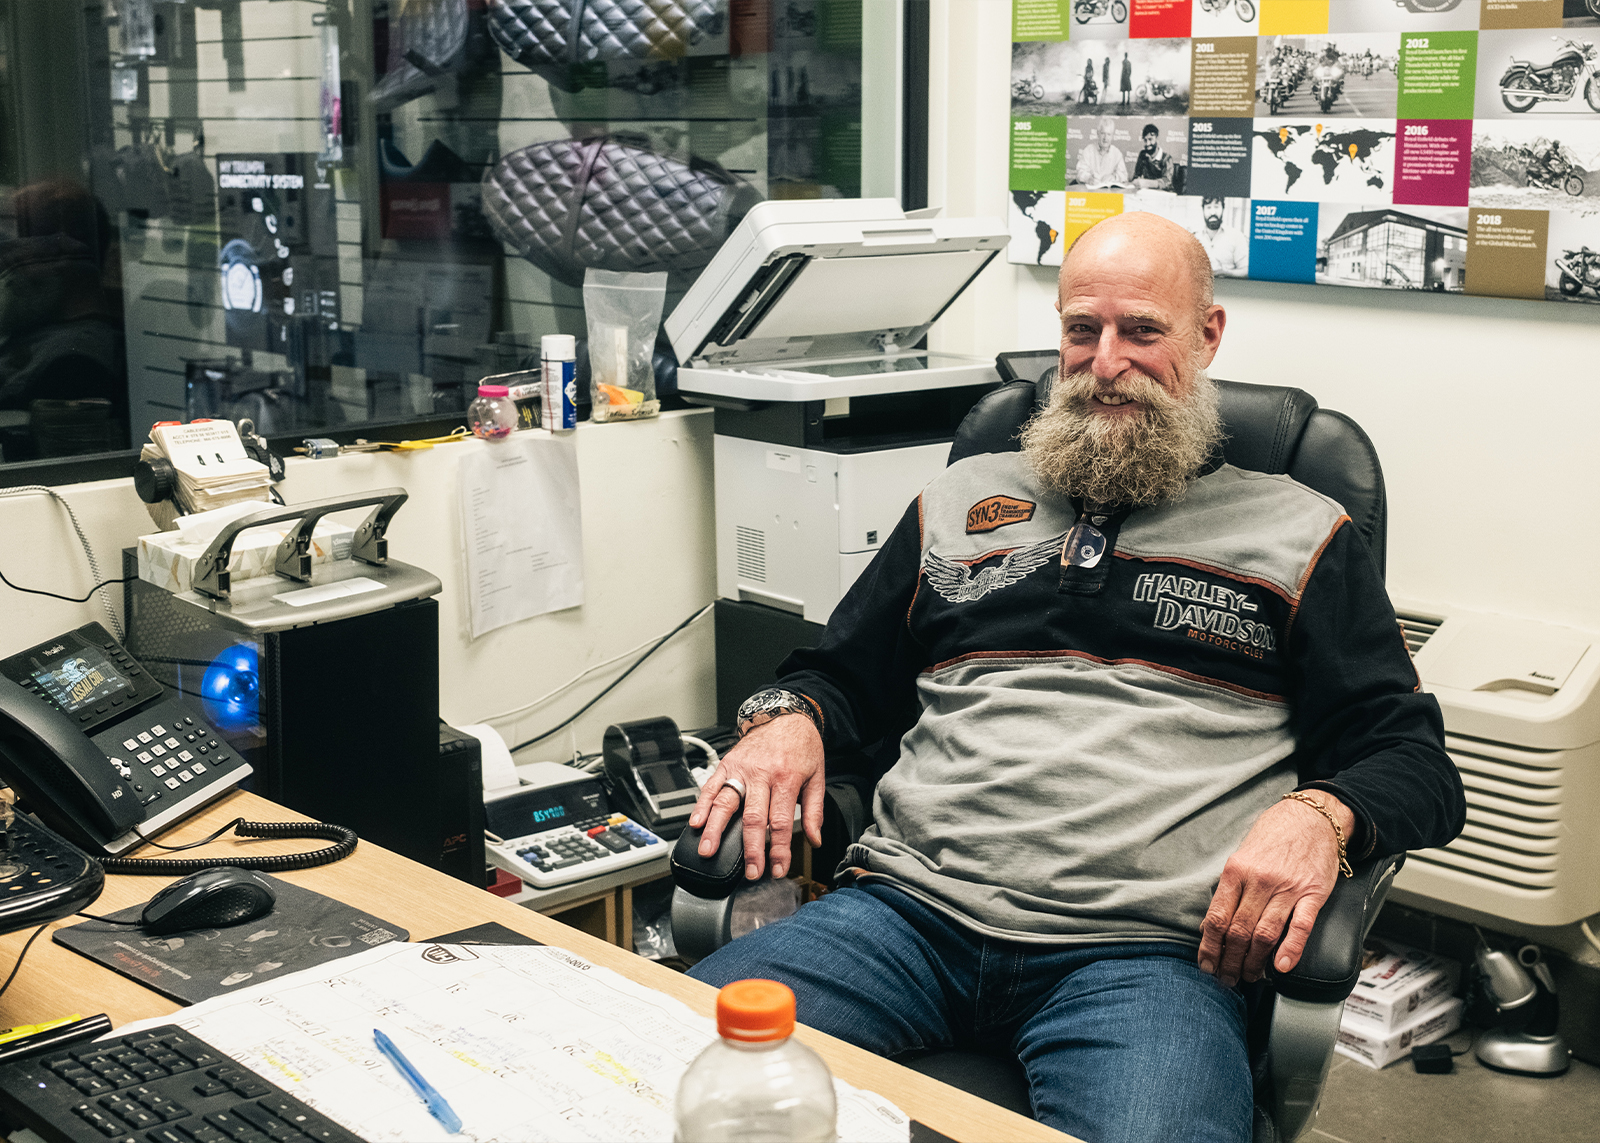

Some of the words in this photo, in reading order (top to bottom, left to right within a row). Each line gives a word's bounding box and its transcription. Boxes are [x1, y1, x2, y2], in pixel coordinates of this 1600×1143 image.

[1195, 43, 1214, 52] 2011
[1406, 38, 1429, 48] 2012
[1014, 122, 1032, 130] 2015
[1192, 122, 1212, 132] 2015
[1404, 125, 1429, 135] 2016
[272, 174, 304, 189] SYSTEM
[1068, 198, 1086, 207] 2017
[1256, 206, 1277, 216] 2017
[1476, 214, 1502, 225] 2018
[969, 501, 1002, 528] SYN3
[1133, 573, 1259, 612] HARLEY-
[1154, 597, 1277, 652] DAVIDSON
[1187, 628, 1264, 660] MOTORCYCLES
[111, 790, 123, 800] HD
[443, 833, 467, 846] APC
